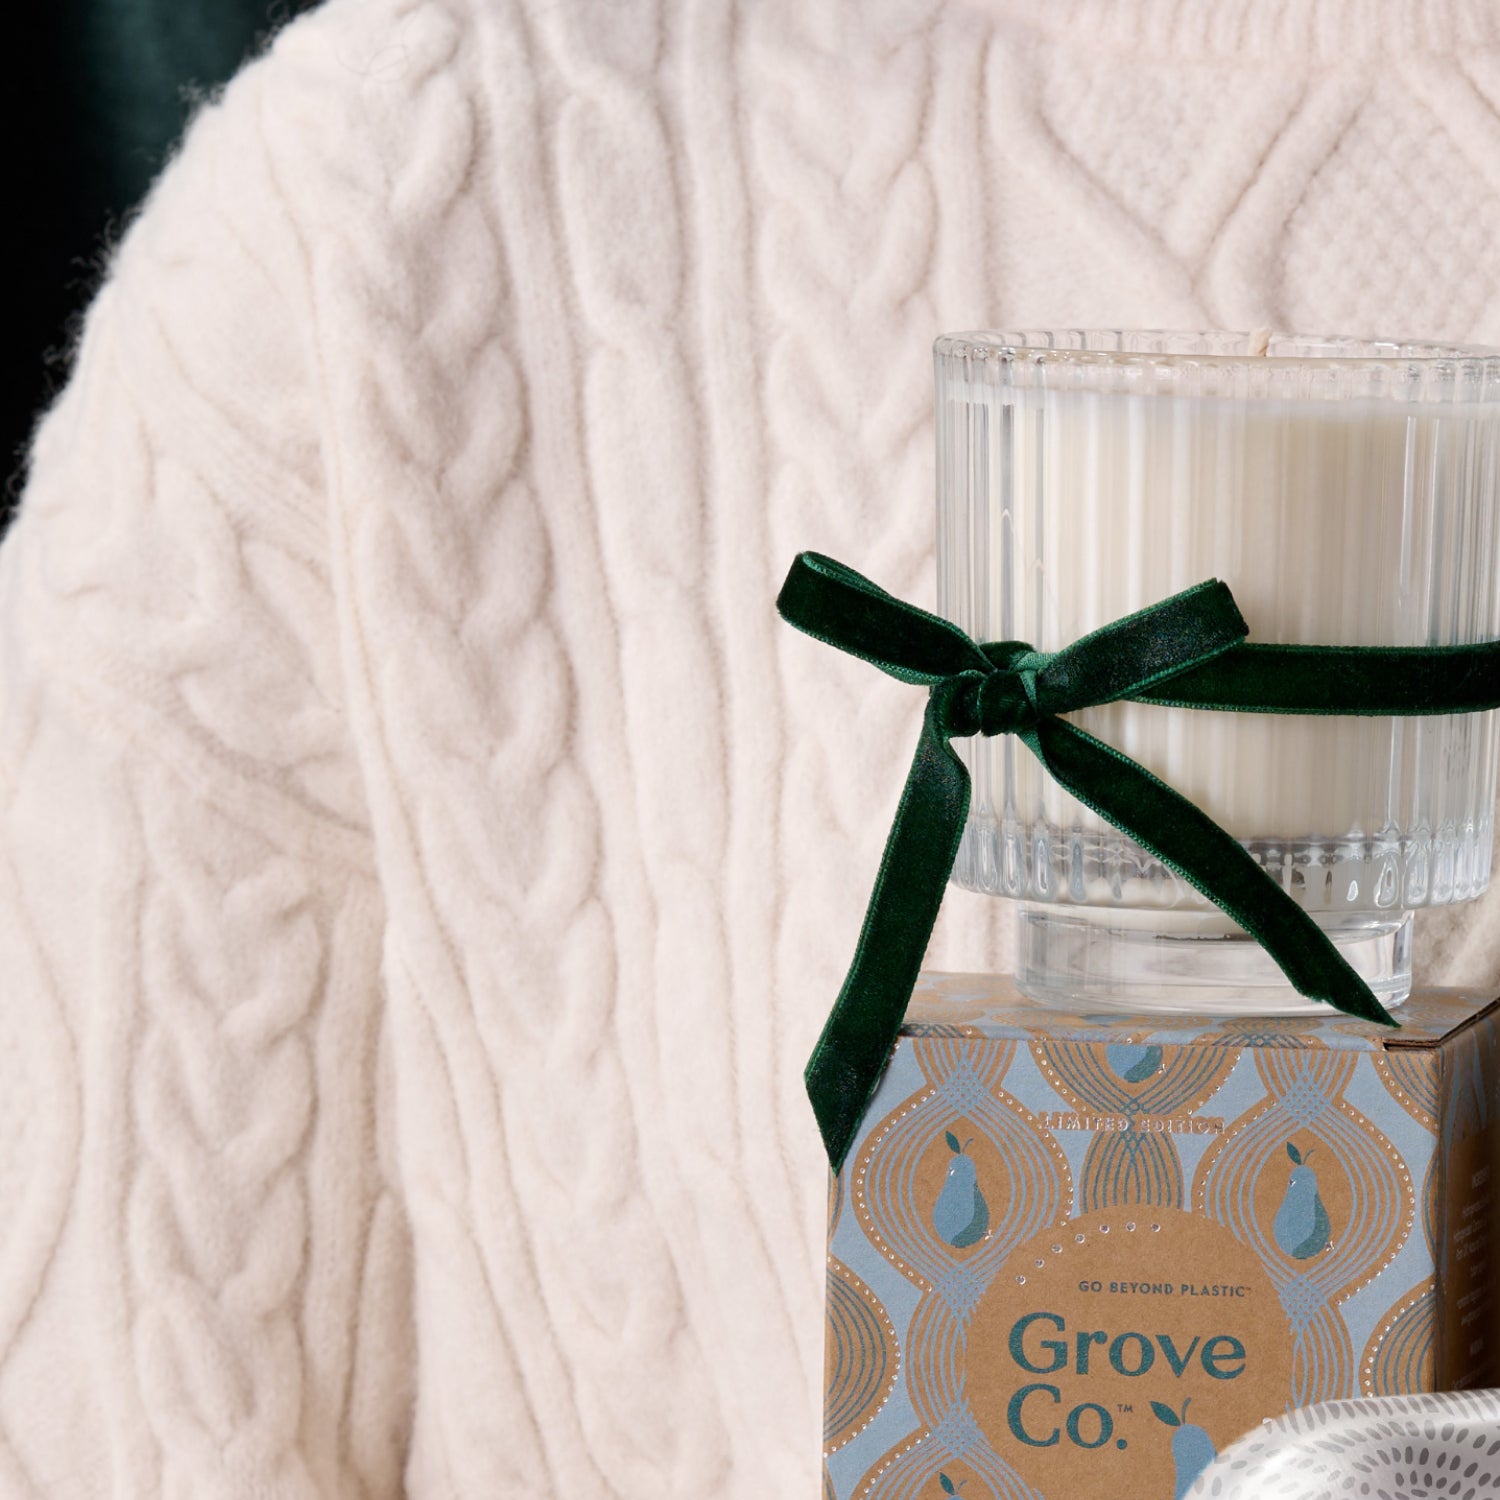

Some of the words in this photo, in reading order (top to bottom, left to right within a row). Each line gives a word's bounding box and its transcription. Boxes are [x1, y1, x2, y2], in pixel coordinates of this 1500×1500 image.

[1043, 1115, 1130, 1132] LIMITED
[1140, 1118, 1226, 1135] EDITION
[1078, 1280, 1103, 1293] GO
[1109, 1281, 1174, 1295] BEYOND
[1007, 1311, 1247, 1381] Grove
